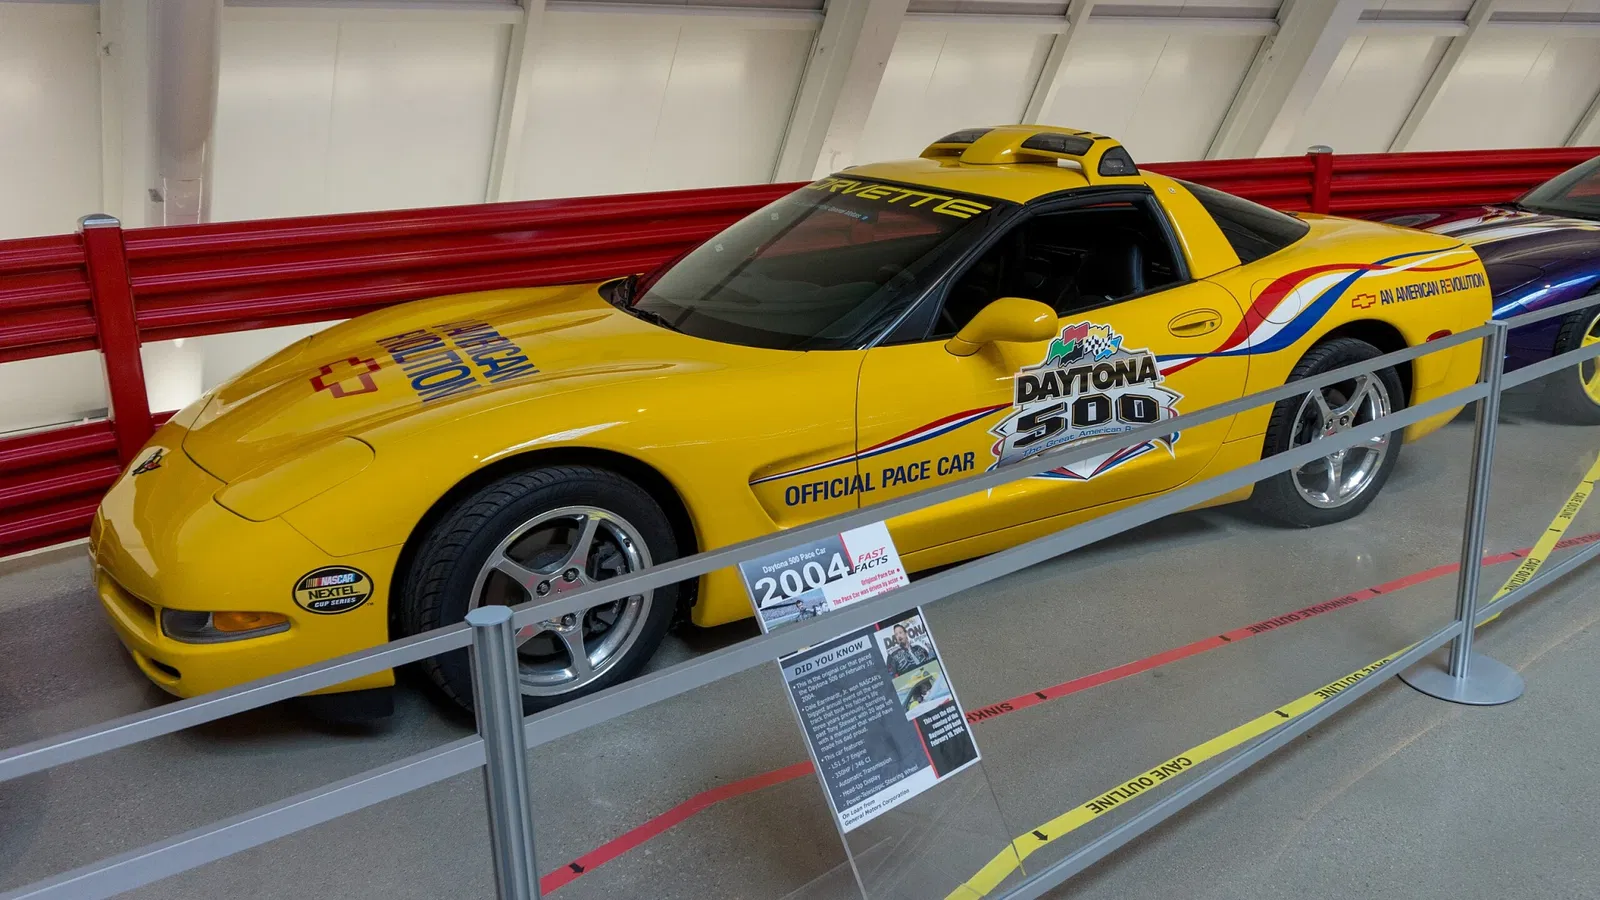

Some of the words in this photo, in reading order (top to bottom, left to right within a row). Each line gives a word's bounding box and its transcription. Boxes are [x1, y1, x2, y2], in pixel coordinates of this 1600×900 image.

[807, 177, 992, 219] ORVETTE
[1380, 290, 1394, 305] AN
[1396, 281, 1439, 302] AMERICAN
[1440, 272, 1485, 294] REVOLUTION
[1016, 355, 1158, 404] DAYTONA
[1013, 393, 1160, 448] 500
[1022, 445, 1042, 457] The
[1046, 434, 1075, 448] Great
[1078, 427, 1122, 438] American
[785, 472, 875, 506] OFFICIAL
[882, 460, 931, 488] PACE
[937, 452, 975, 476] CAR
[762, 561, 788, 573] Daytona
[789, 556, 799, 564] 500
[800, 552, 815, 560] Pace
[854, 555, 888, 573] FACTS
[858, 547, 886, 563] FAST
[1524, 558, 1541, 572] CAVE
[321, 573, 354, 586] NASCAR
[755, 552, 849, 608] 2004
[308, 585, 358, 600] NEXTEL
[314, 600, 329, 608] CUP
[330, 597, 357, 606] SERIES
[1299, 596, 1358, 617] SINKHOLE
[1245, 613, 1300, 634] OUTLINE
[795, 663, 812, 675] DID
[815, 653, 833, 666] YOU
[836, 641, 862, 658] KNOW
[822, 667, 839, 678] original
[858, 653, 871, 663] paced
[808, 680, 828, 692] Daytona
[845, 664, 865, 675] February
[859, 675, 881, 687] NASCAR's
[807, 707, 825, 718] biggest
[826, 700, 842, 709] annual
[843, 693, 856, 702] event
[872, 681, 883, 689] same
[810, 717, 823, 725] track
[823, 711, 834, 719] that
[834, 706, 845, 714] took
[813, 723, 826, 731] three
[827, 717, 840, 726] years
[865, 695, 886, 708] barreling
[932, 718, 948, 729] running
[816, 730, 826, 739] past
[827, 725, 838, 733] Tony
[839, 716, 857, 727] Stewart
[858, 711, 868, 719] with
[818, 737, 829, 745] with
[834, 724, 856, 738] maneuver
[858, 719, 867, 727] that
[868, 712, 882, 721] would
[929, 728, 945, 739] Daytona
[821, 743, 834, 752] made
[843, 733, 852, 741] dad
[931, 735, 948, 746] February
[831, 761, 841, 769] LS1
[841, 756, 849, 764] 5.7
[850, 749, 866, 759] Engine
[855, 760, 864, 768] 346
[1150, 757, 1192, 780] CAVE
[839, 773, 862, 787] Automatic
[863, 758, 892, 774] Transmission
[885, 773, 904, 785] Steering
[904, 765, 918, 775] Wheel
[843, 783, 863, 796] Head-Up
[863, 775, 880, 785] Display
[1085, 777, 1154, 814] OUTLINE
[845, 812, 864, 826] General
[865, 804, 881, 815] Motors
[882, 789, 909, 806] Corporation
[851, 806, 863, 815] Loan
[863, 800, 875, 808] from
